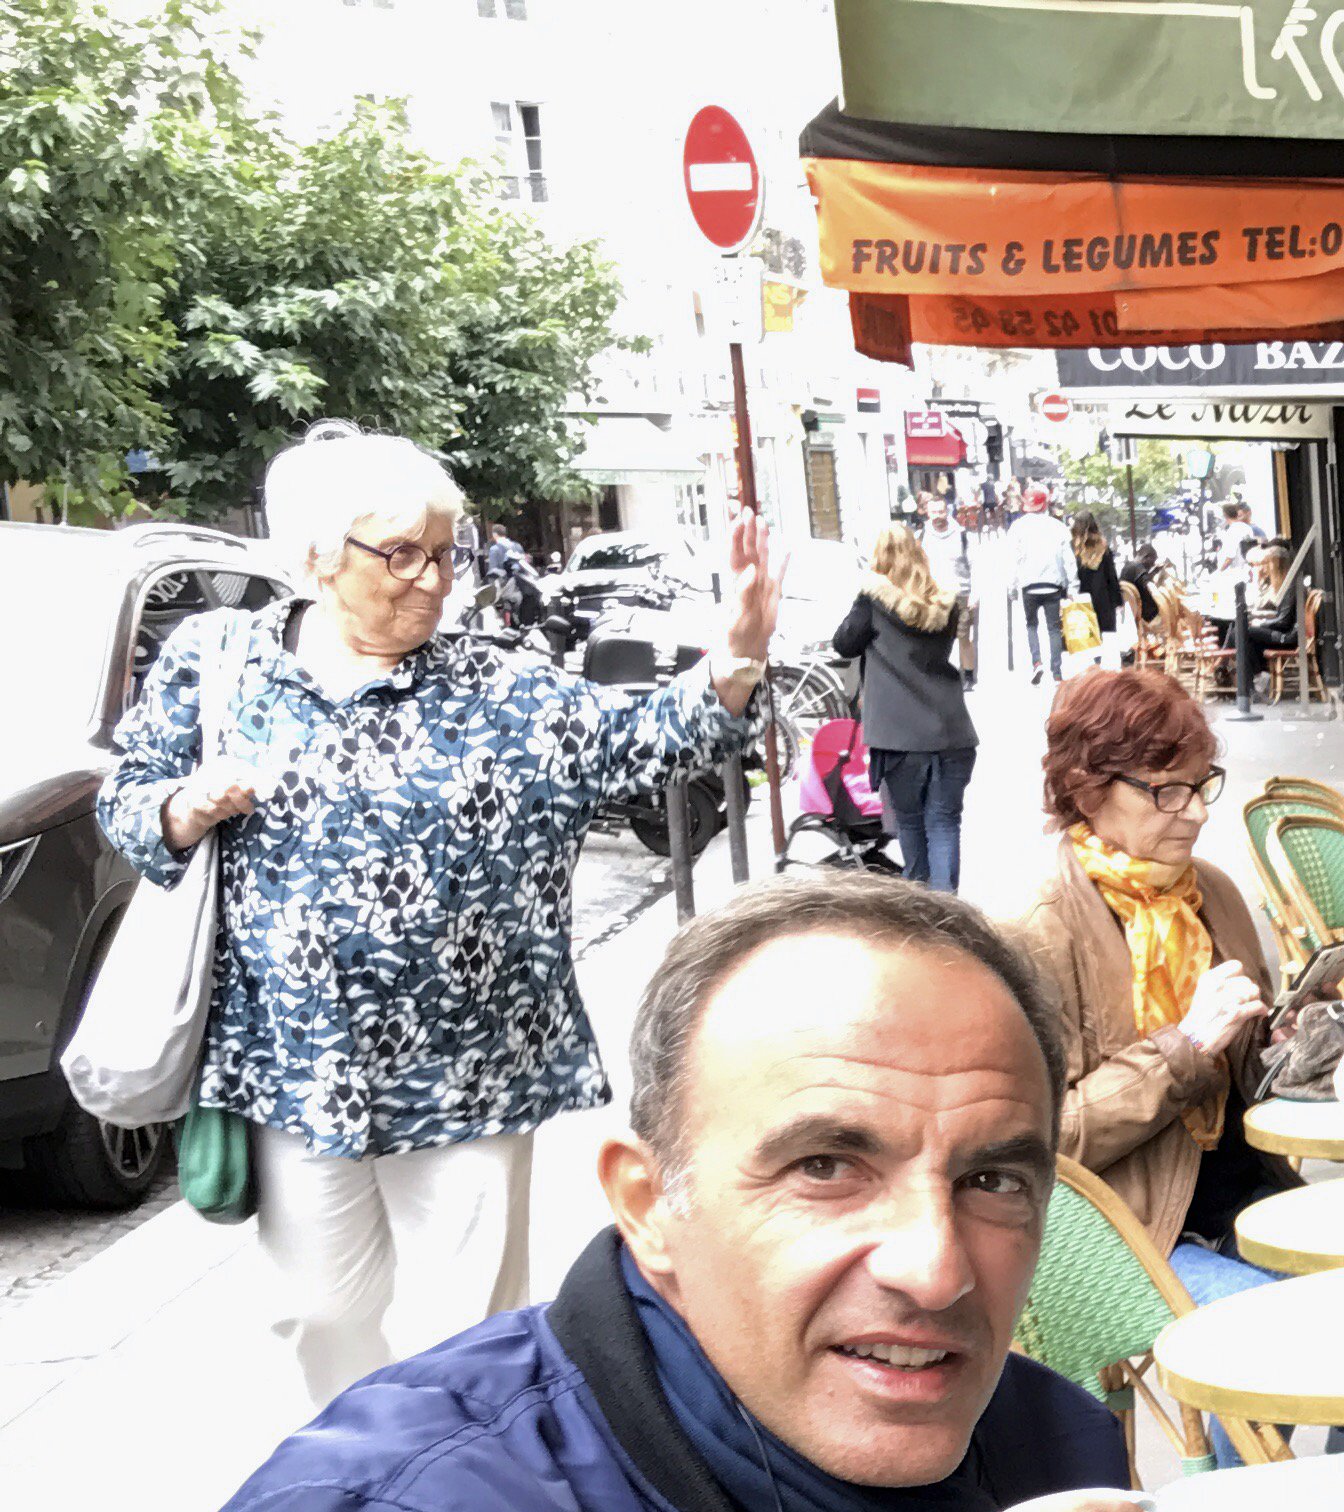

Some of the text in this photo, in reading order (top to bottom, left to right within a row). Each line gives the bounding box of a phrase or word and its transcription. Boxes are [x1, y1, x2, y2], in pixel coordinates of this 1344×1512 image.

[851, 238, 988, 276] FRUITS
[1000, 241, 1027, 276] &
[1041, 230, 1221, 274] LEGUMES
[1088, 343, 1226, 372] COCO
